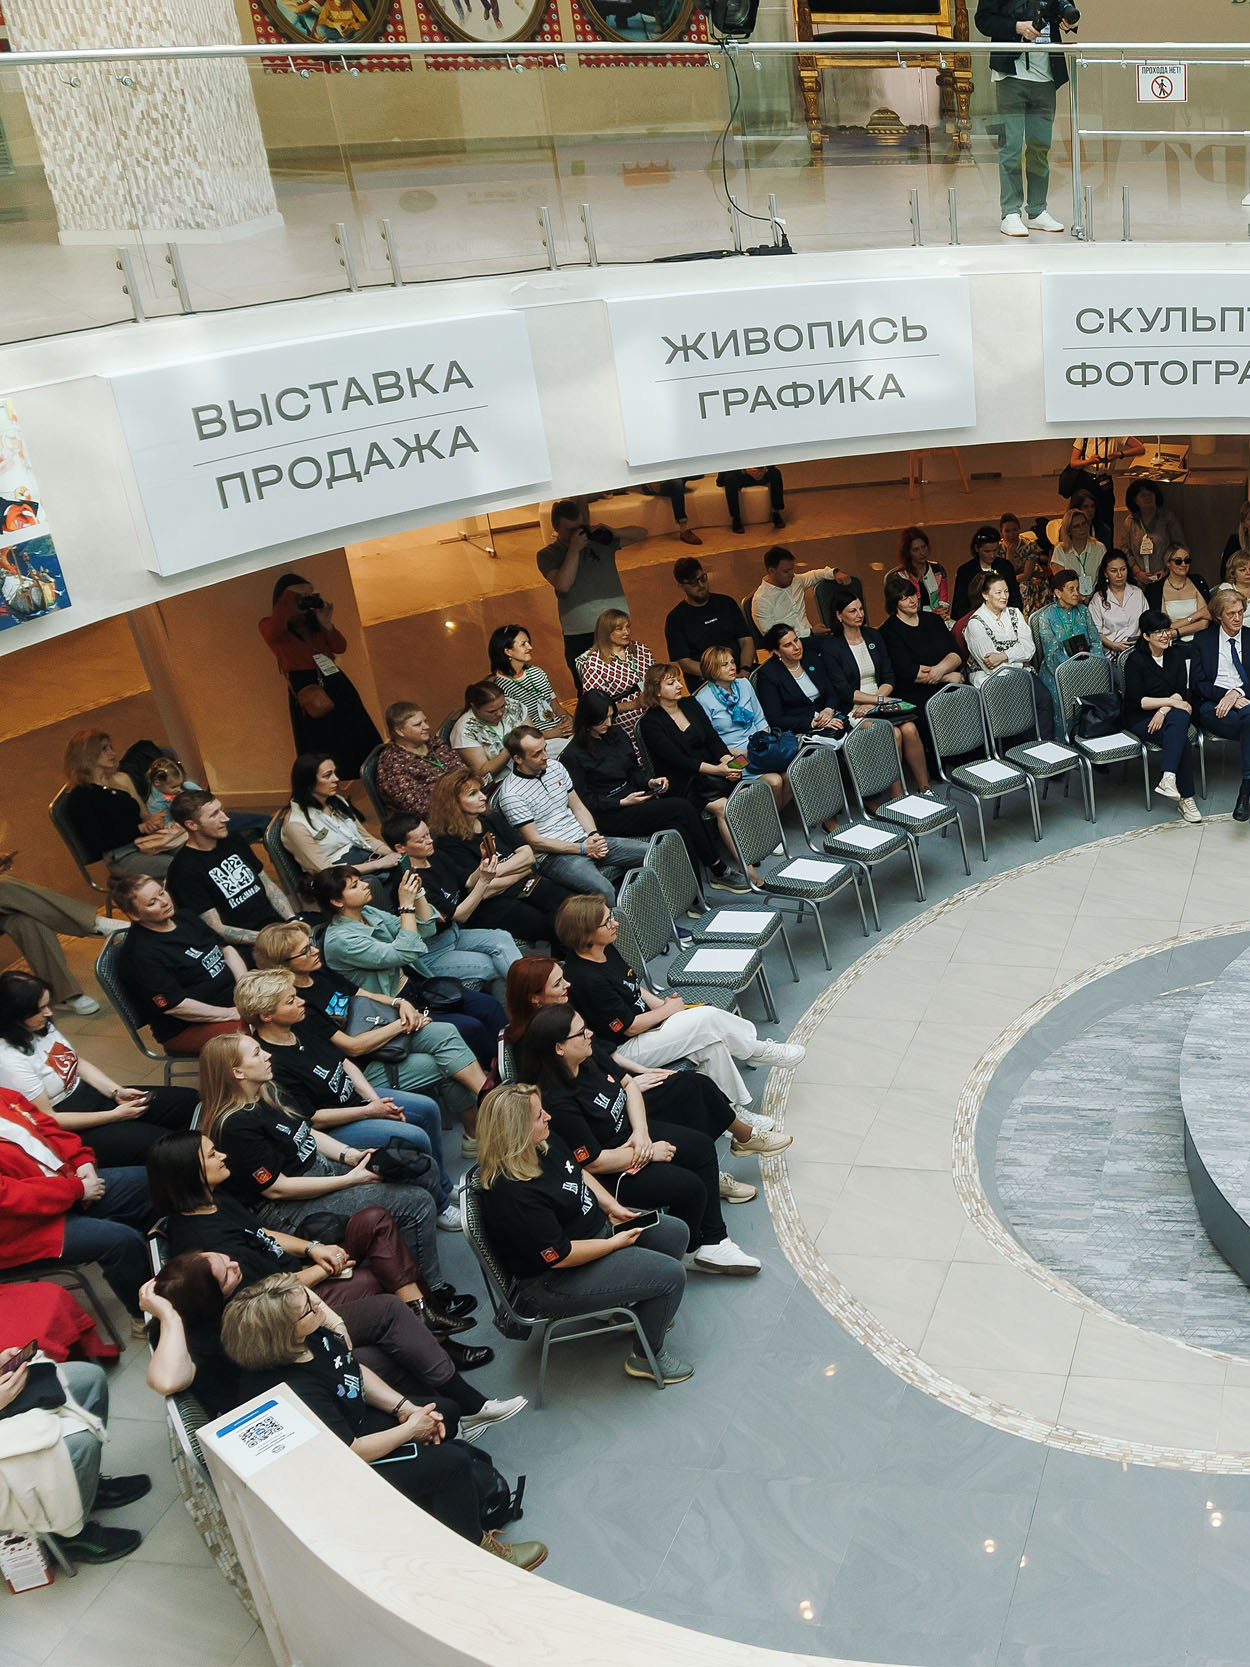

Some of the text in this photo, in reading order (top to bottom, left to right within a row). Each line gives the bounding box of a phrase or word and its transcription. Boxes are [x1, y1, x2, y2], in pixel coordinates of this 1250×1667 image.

[1142, 66, 1182, 74] ПРОХОДА НЕТ!
[661, 316, 928, 364] ЖИВОПИСЬ
[191, 360, 474, 441] ВЫСТАВКА
[698, 373, 906, 419] ГРАФИКА
[215, 425, 480, 509] ПРОДАЖА
